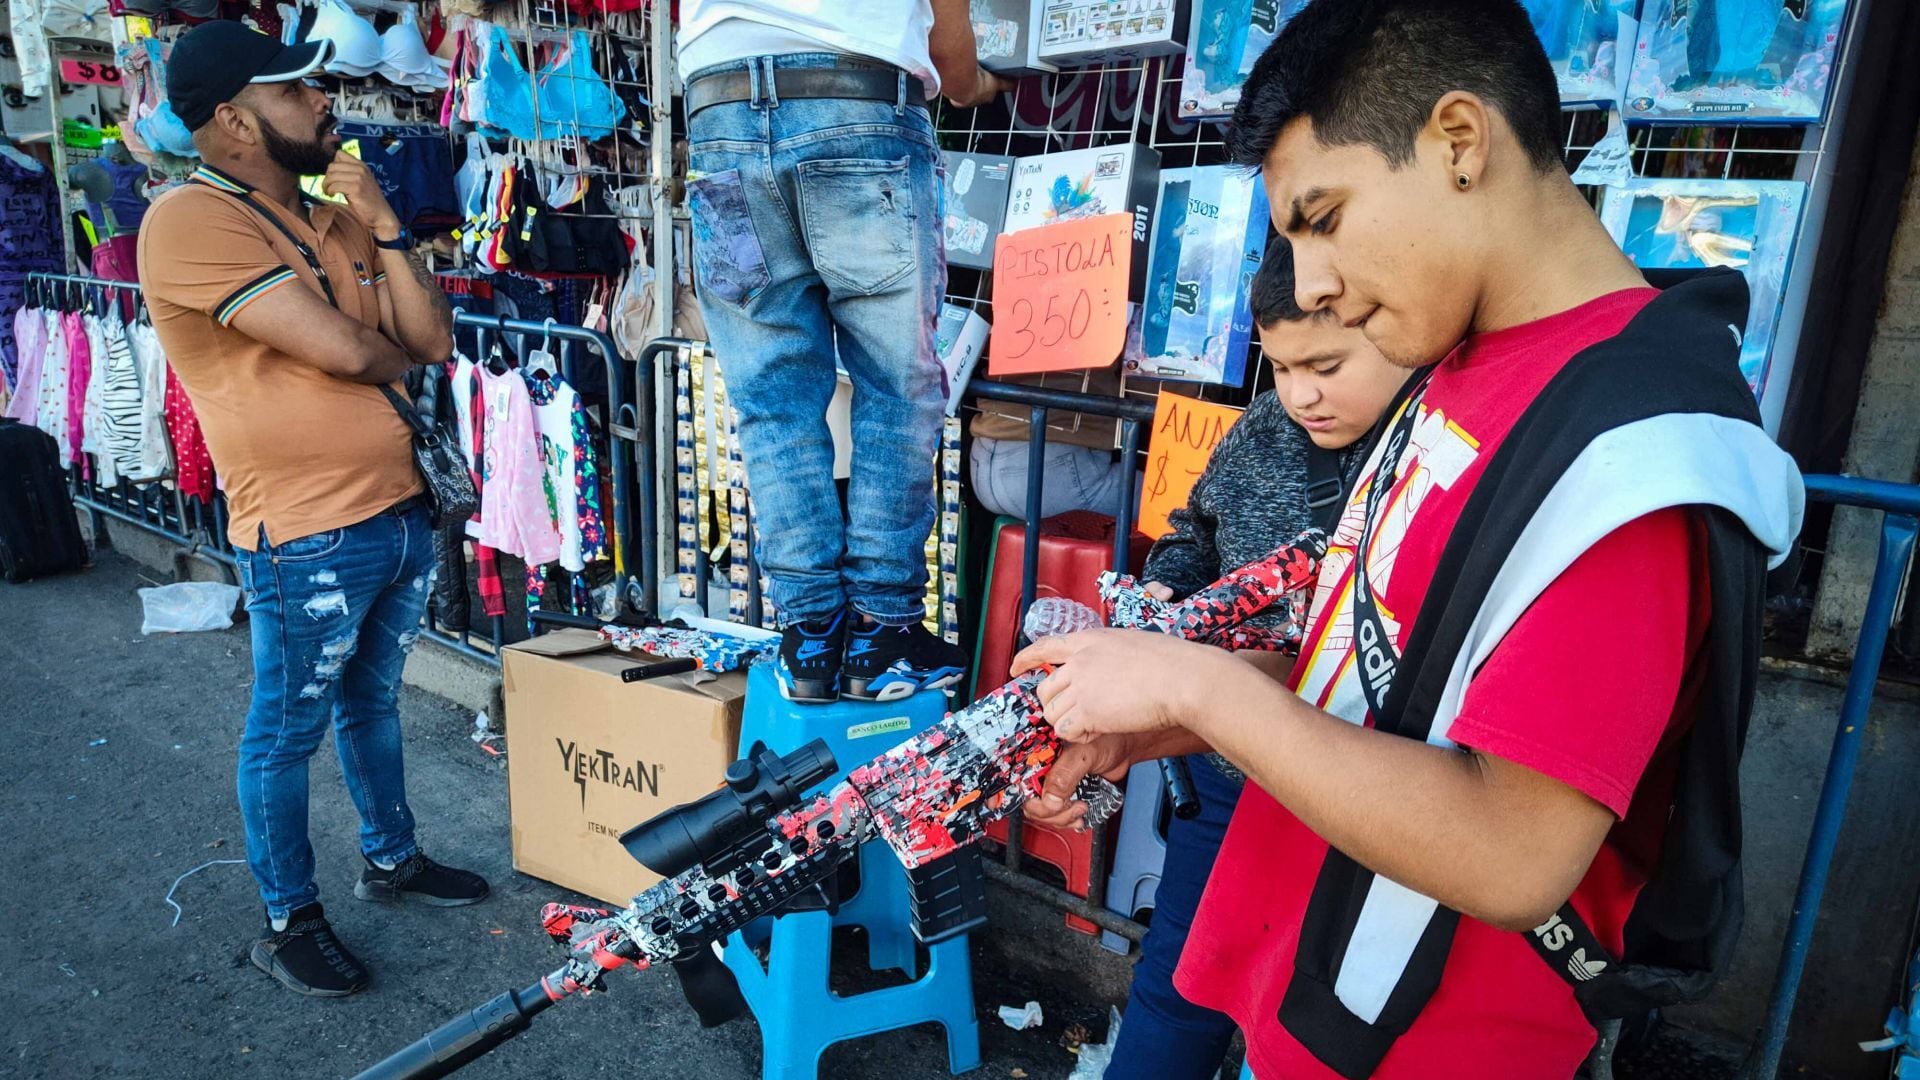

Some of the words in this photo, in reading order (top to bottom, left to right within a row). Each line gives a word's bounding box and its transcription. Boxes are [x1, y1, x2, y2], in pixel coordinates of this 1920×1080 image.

[1133, 204, 1149, 242] 2011
[1000, 233, 1114, 285] PISTOLA
[801, 639, 826, 652] NIKE
[801, 660, 827, 668] AIR
[588, 821, 606, 835] ITEM
